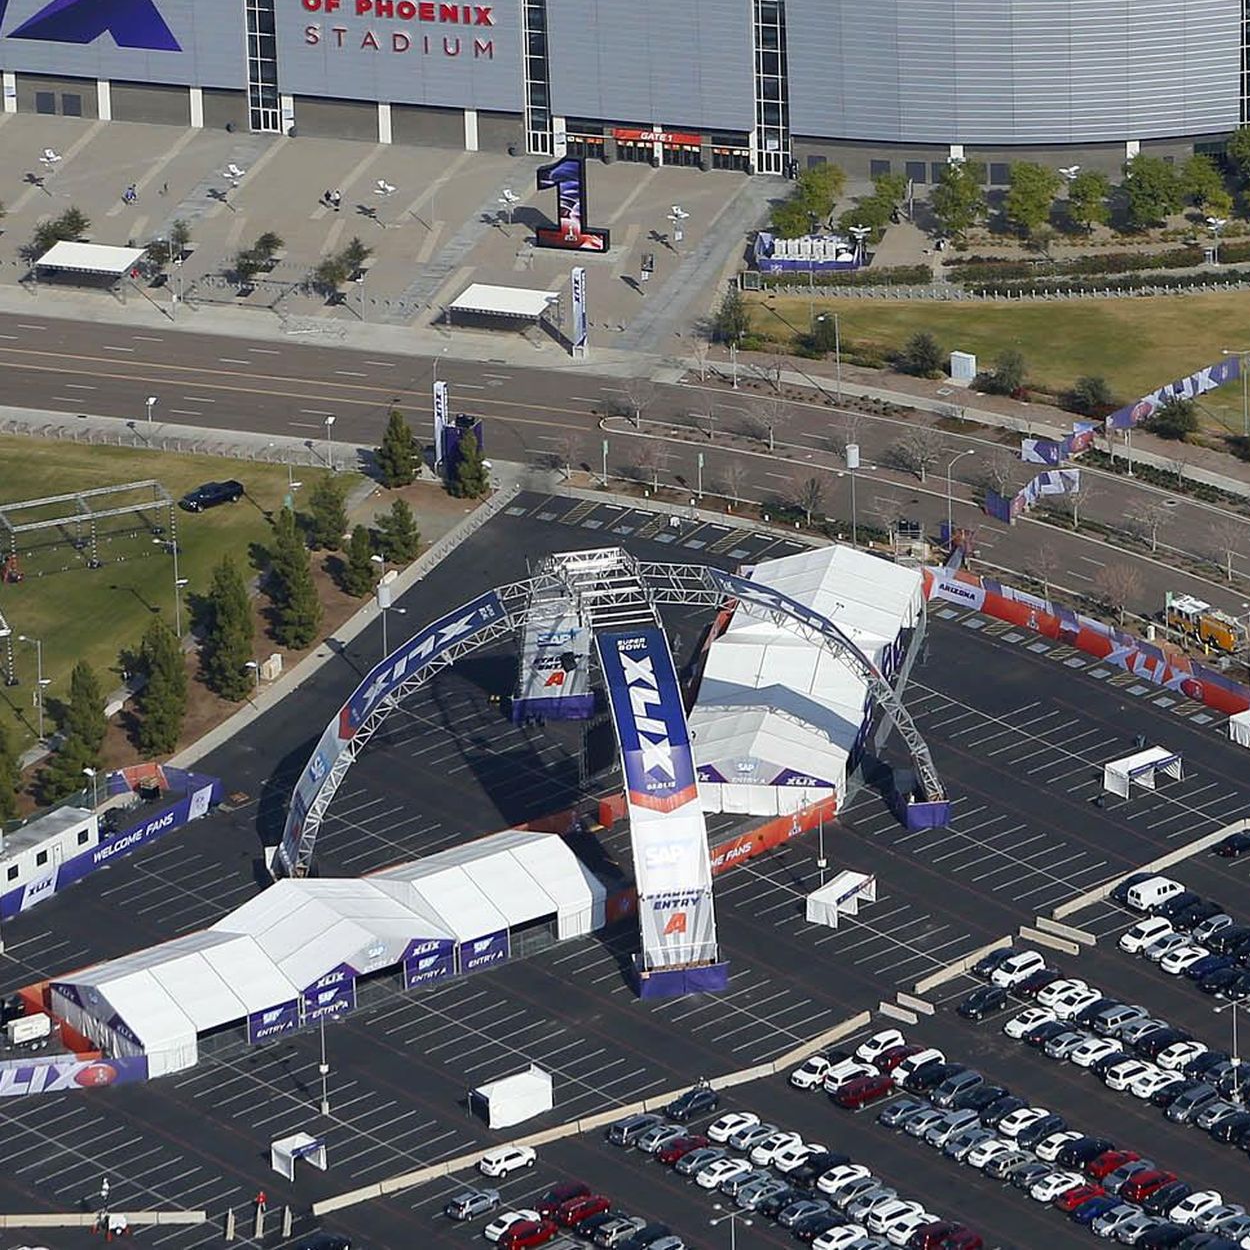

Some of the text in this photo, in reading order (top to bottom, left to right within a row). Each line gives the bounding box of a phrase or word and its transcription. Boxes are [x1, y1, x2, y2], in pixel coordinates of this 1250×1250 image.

[304, 25, 494, 60] STADIUM
[640, 131, 667, 142] GATE
[938, 583, 977, 601] ARIZONA
[618, 643, 648, 651] BOWL
[362, 610, 478, 715] XLIX
[544, 671, 565, 687] A
[619, 651, 676, 780] XLIX
[786, 776, 818, 787] XLIX
[93, 812, 175, 863] WELCOME FANS
[726, 841, 753, 861] FANS
[653, 898, 700, 910] ENTRY
[663, 912, 687, 935] A
[412, 940, 440, 957] XLIX
[468, 950, 504, 968] ENTRY A
[316, 972, 345, 989] XLIX
[411, 967, 447, 983] ENTRY A
[256, 1021, 293, 1038] ENTRY A
